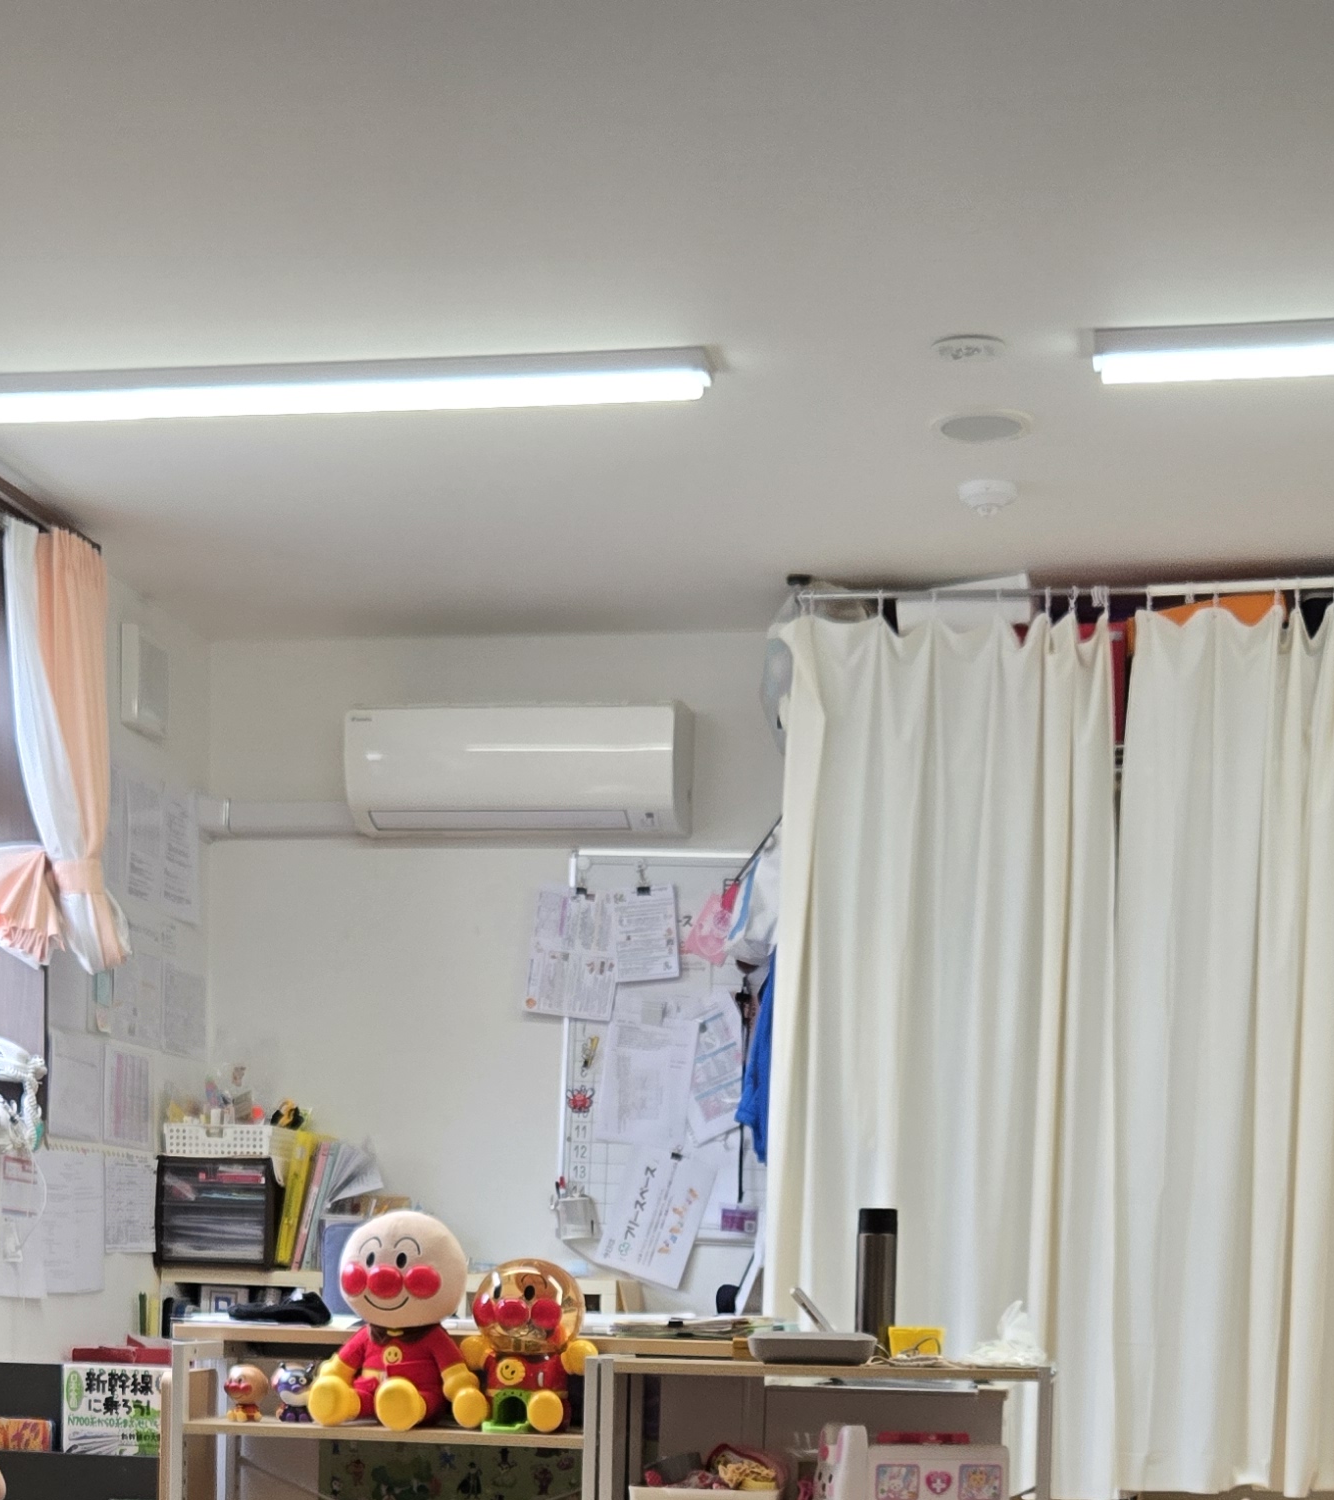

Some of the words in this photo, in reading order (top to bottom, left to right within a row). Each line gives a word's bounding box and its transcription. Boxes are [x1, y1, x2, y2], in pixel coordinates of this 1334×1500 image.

[574, 1125, 588, 1138] 11
[573, 1146, 588, 1159] 12
[572, 1166, 587, 1179] 13
[624, 1166, 657, 1241] フリースペース
[85, 1372, 154, 1395] 新幹線
